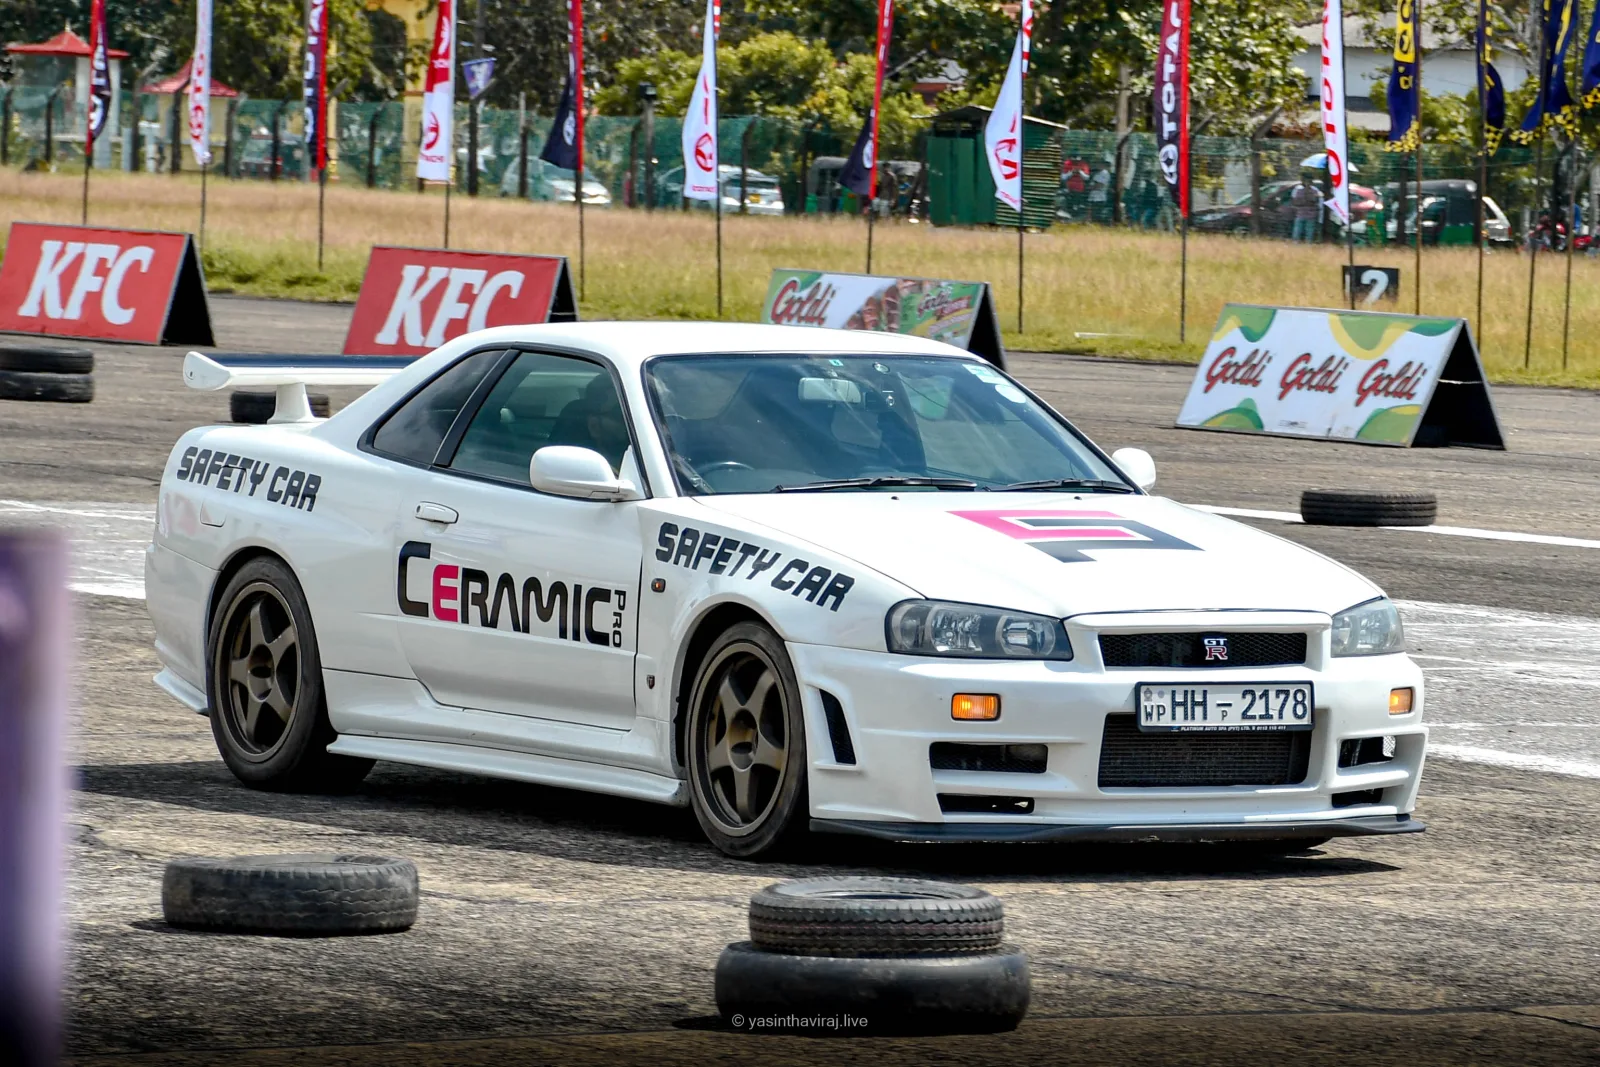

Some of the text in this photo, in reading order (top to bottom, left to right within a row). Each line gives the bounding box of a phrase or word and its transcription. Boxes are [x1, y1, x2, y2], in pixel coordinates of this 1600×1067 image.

[17, 240, 155, 325] KFC
[374, 264, 525, 347] KFC
[771, 279, 836, 325] Goldi
[1203, 346, 1427, 407] Goldi Goldi Goldi
[177, 446, 322, 512] SAFETY CAR
[397, 540, 612, 646] CERAMIC
[655, 521, 855, 613] SAFETY CAR
[612, 589, 627, 648] PRO
[1203, 638, 1228, 646] GT
[1205, 645, 1228, 660] R
[1143, 704, 1166, 722] WP
[1171, 689, 1208, 721] HH
[1241, 688, 1308, 720] 2178
